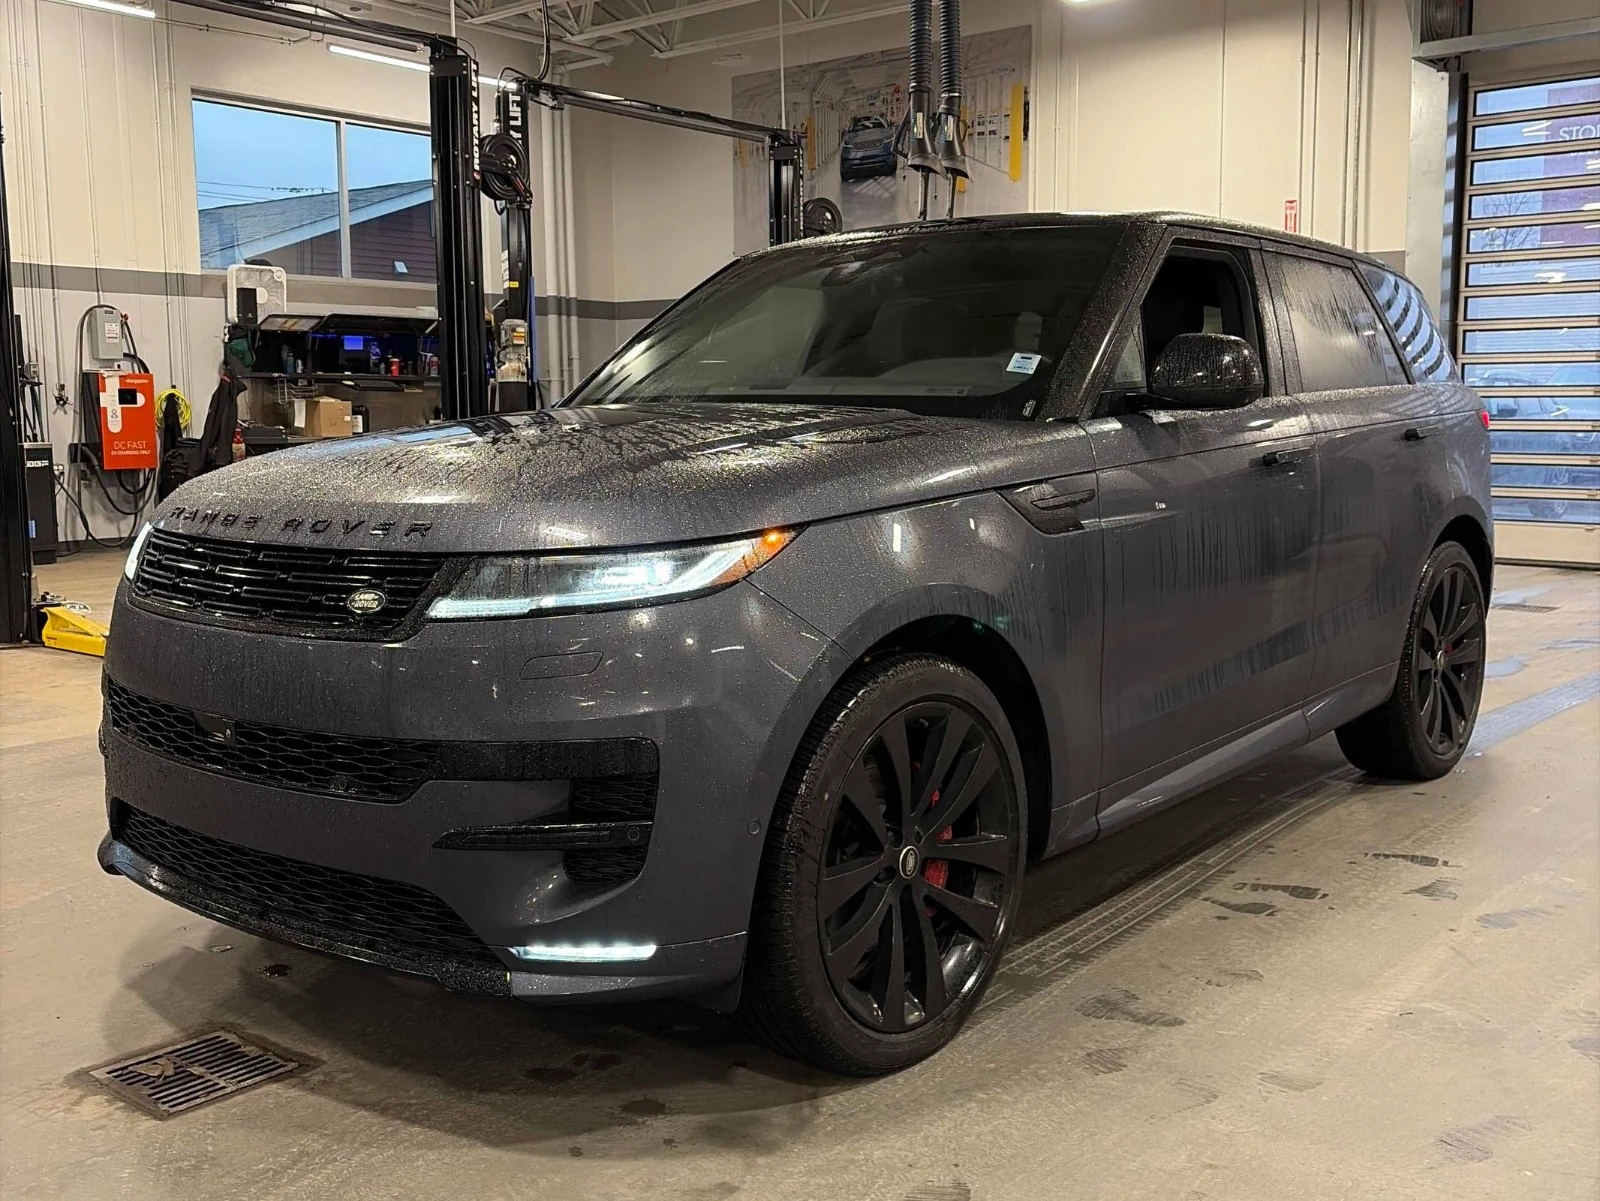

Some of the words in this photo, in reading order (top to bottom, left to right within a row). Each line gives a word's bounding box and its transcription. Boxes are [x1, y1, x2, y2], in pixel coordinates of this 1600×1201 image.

[471, 60, 479, 97] LIFT
[509, 93, 522, 126] LIFT
[472, 101, 480, 170] ROTARY
[113, 441, 126, 450] DC
[127, 440, 147, 449] FAST
[170, 507, 262, 529] RANGE
[281, 517, 433, 538] ROVER
[353, 600, 379, 608] ROVER
[354, 593, 376, 601] LAND
